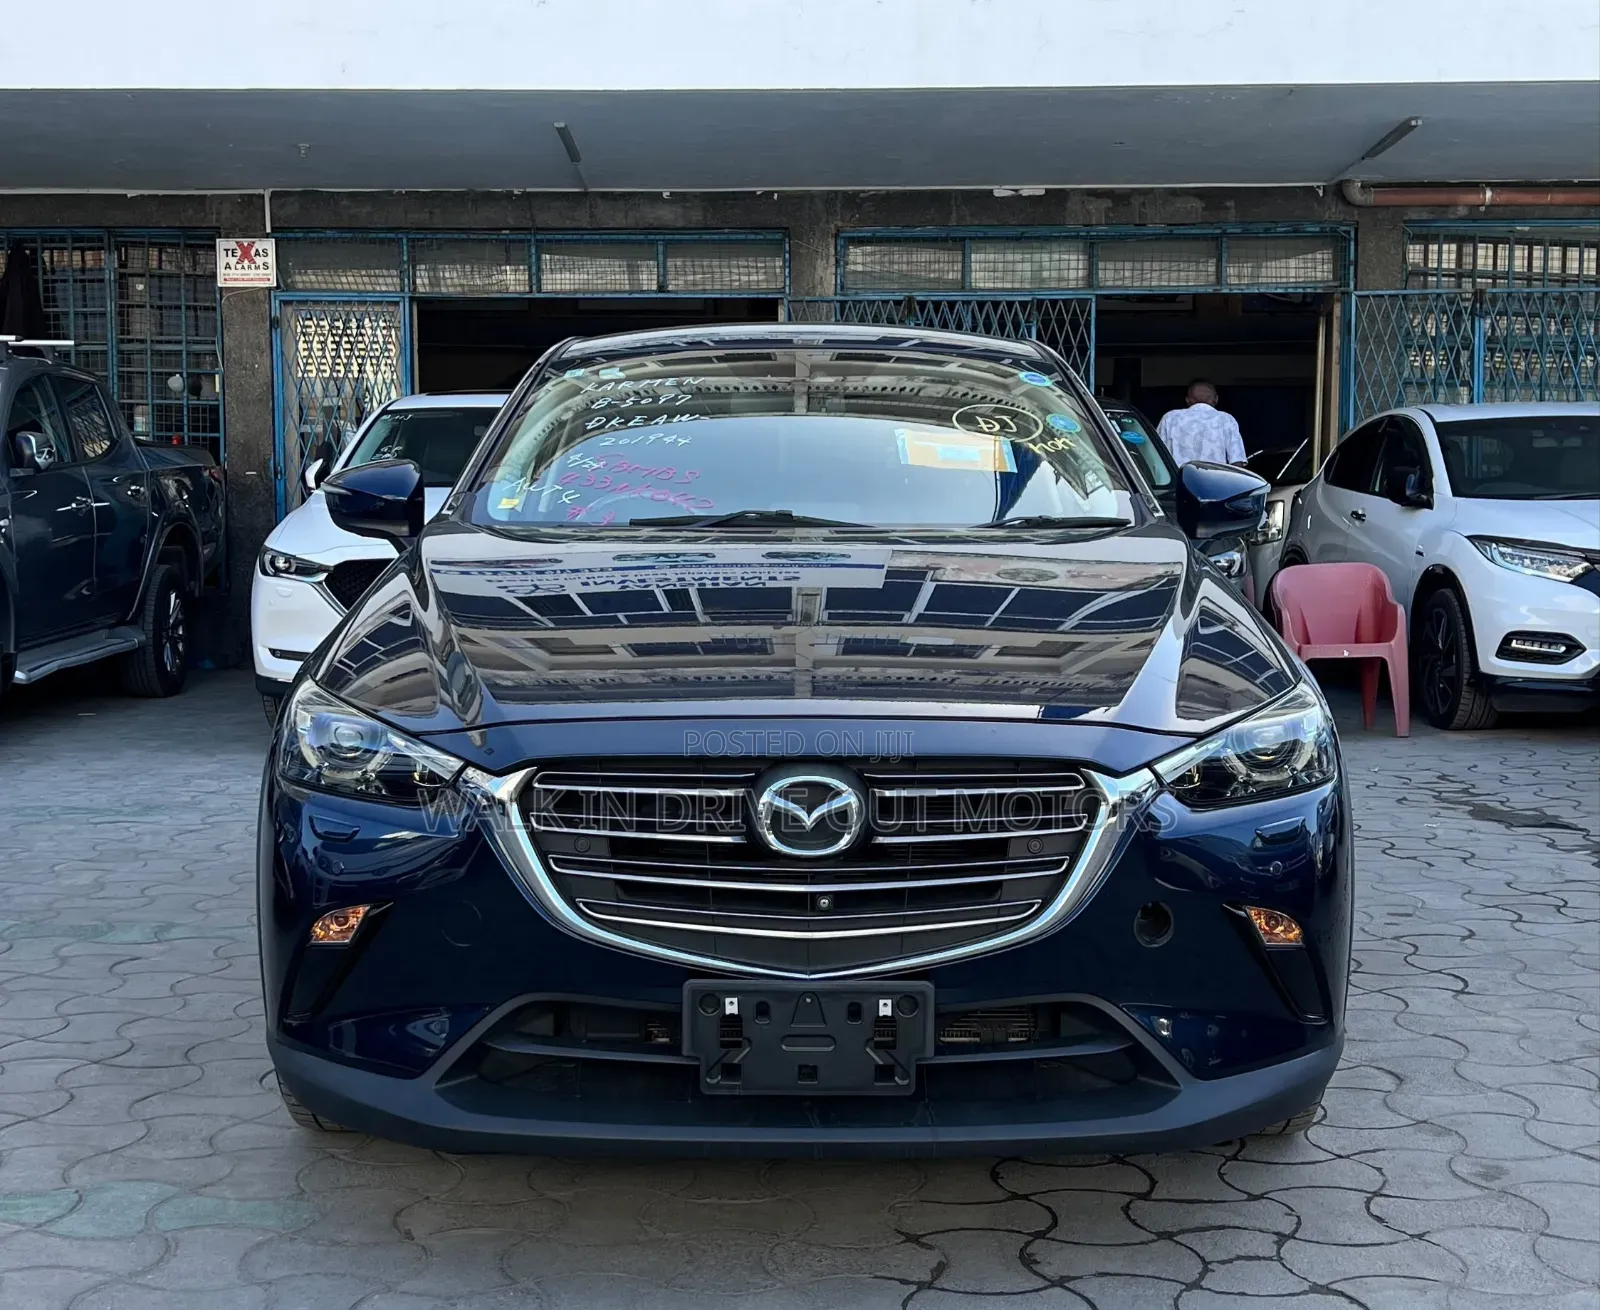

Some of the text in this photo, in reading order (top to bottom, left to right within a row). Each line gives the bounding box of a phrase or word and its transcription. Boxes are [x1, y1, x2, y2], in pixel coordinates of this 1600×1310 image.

[223, 241, 269, 264] TEXAS
[224, 262, 270, 271] ALARMS
[580, 377, 705, 394] KARMEN
